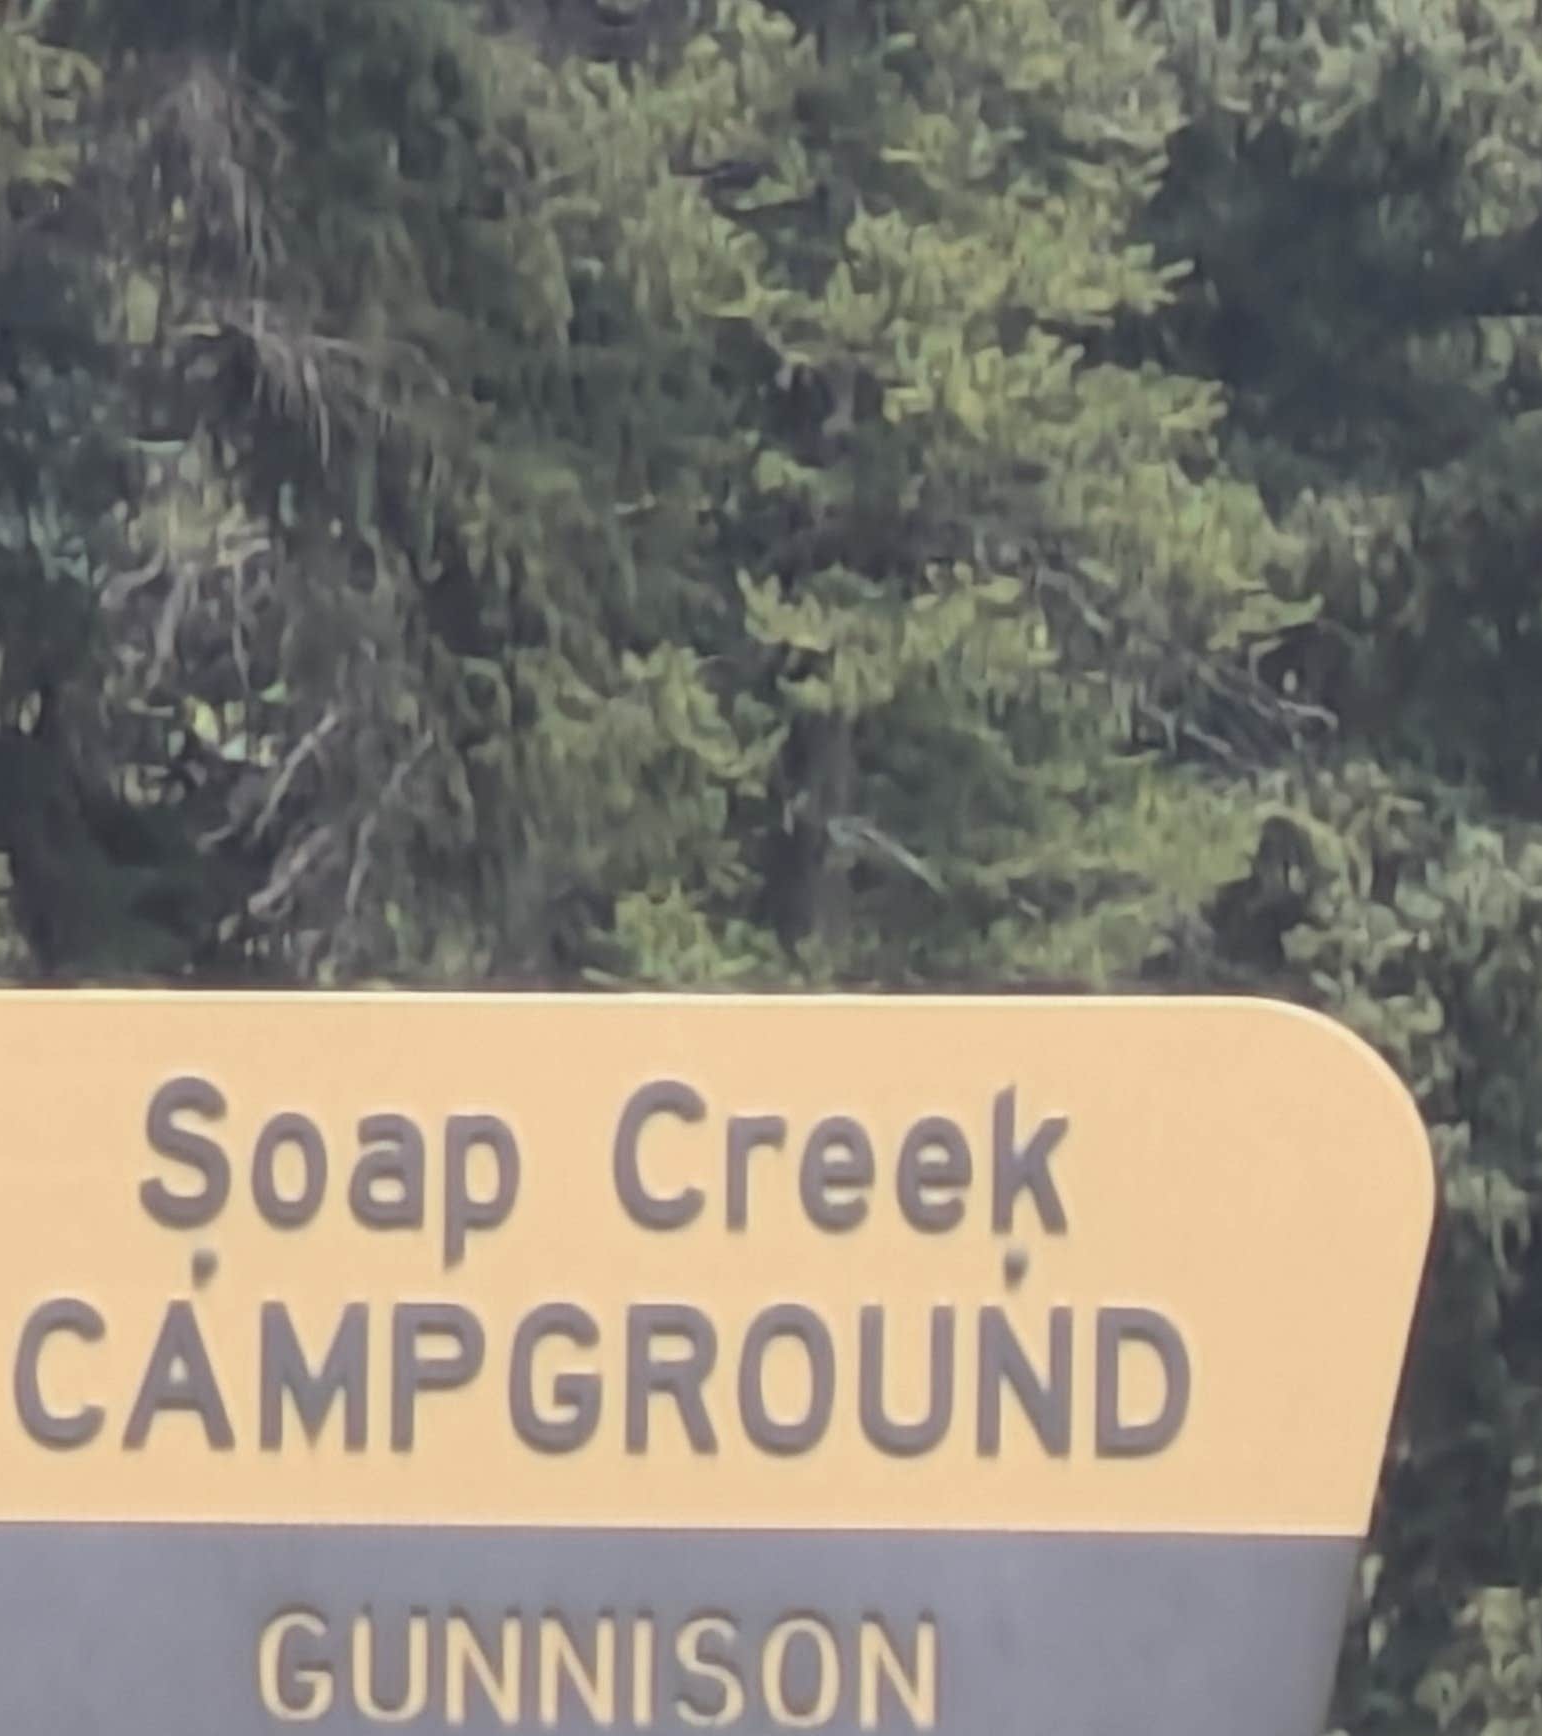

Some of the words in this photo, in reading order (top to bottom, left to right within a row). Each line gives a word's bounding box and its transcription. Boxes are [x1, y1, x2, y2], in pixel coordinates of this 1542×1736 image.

[140, 1077, 520, 1270] Soap
[613, 1081, 1069, 1236] Creek
[14, 1299, 1190, 1459] CAMPGROUND
[260, 1612, 935, 1729] GUNNISON
